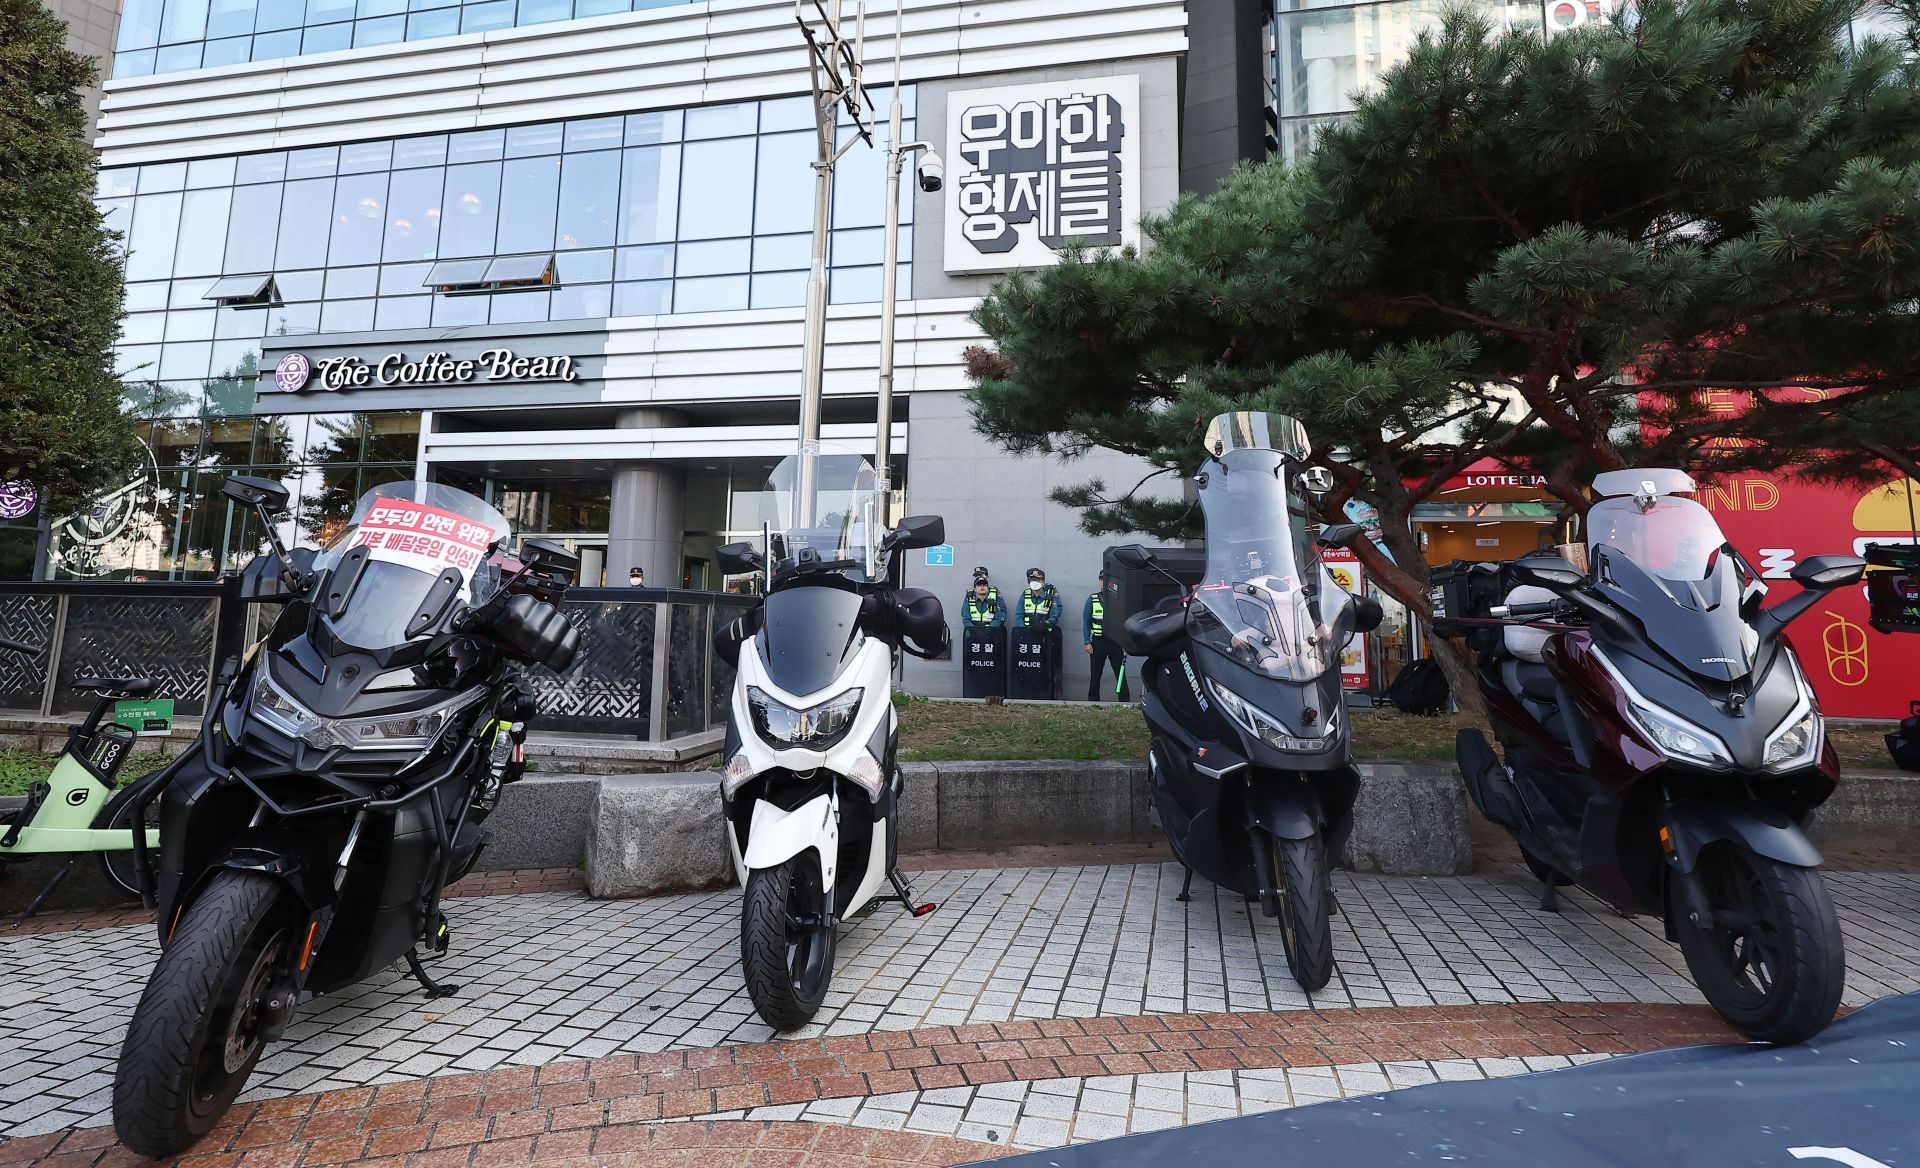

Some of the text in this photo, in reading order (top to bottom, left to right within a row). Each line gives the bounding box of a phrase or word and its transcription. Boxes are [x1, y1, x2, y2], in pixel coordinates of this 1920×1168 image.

[960, 93, 1112, 171] 우아한
[959, 167, 1109, 241] 형제들
[316, 355, 369, 391] The
[376, 352, 473, 385] Coffee
[479, 348, 576, 383] Bean
[1694, 479, 1780, 511] ND
[366, 507, 491, 547] 모두의 안전 위한
[352, 530, 480, 570] 기본 배달운임 인상!
[936, 554, 943, 563] 2
[100, 744, 120, 769] GCOO
